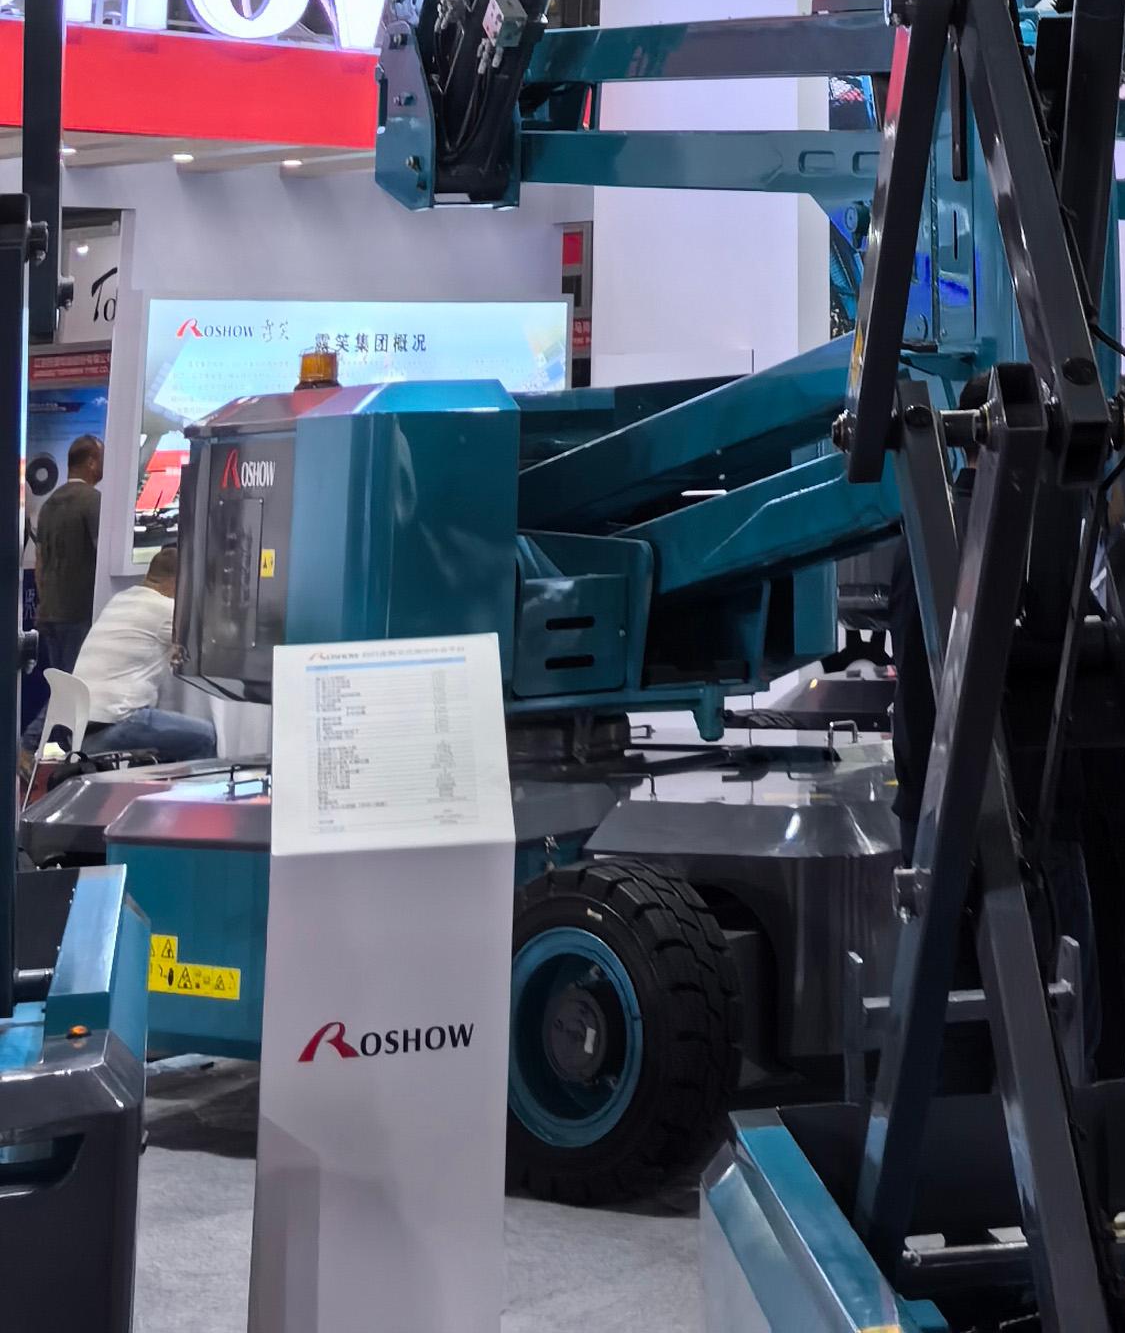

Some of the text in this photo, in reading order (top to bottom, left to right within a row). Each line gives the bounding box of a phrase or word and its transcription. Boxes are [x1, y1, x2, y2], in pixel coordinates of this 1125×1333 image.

[177, 318, 253, 337] ROSHOW
[222, 449, 276, 489] ROSHOW
[298, 1021, 474, 1063] ROSHOW
